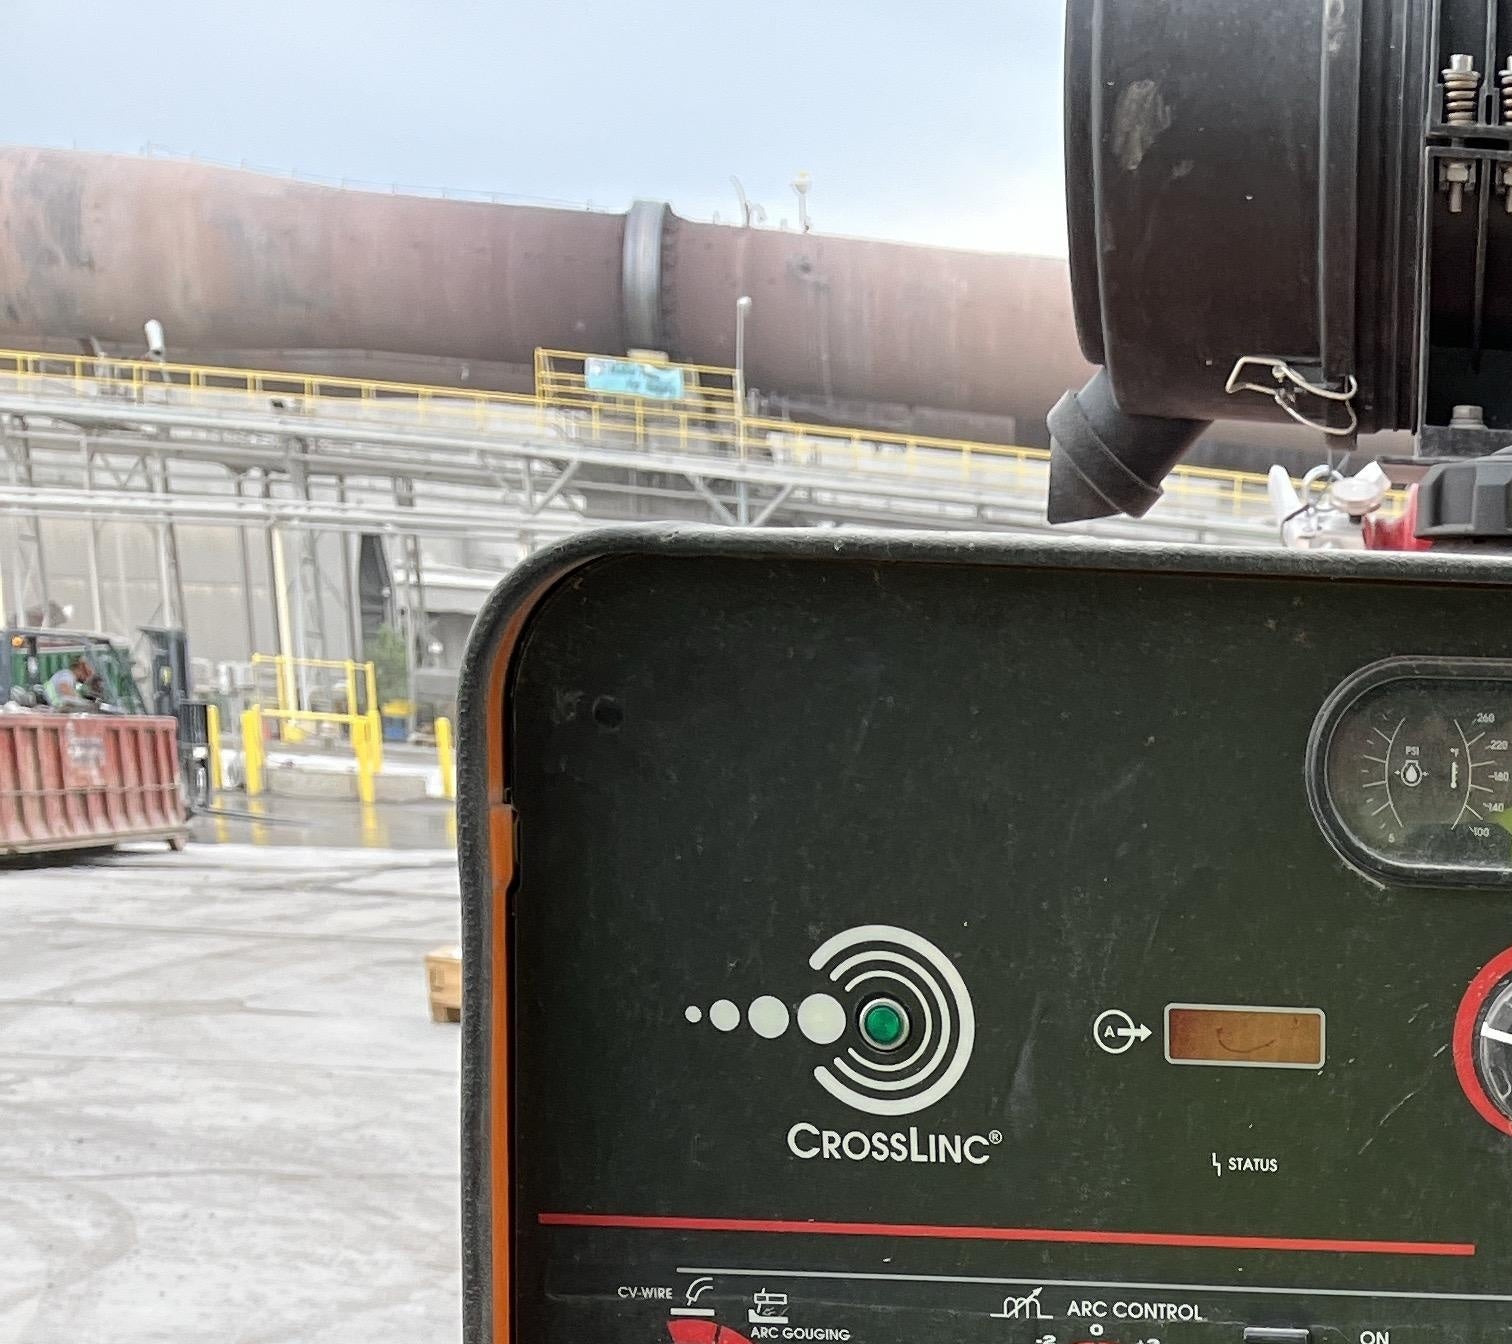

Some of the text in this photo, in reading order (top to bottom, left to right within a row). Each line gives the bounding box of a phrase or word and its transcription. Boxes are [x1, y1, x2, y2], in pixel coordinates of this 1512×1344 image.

[1228, 1157, 1278, 1172] STATUS
[617, 1287, 673, 1300] CV-WIRE
[1067, 1301, 1203, 1320] ARC CONTROL
[751, 1327, 850, 1341] ARC GOUGING
[1090, 1324, 1104, 1335] 0
